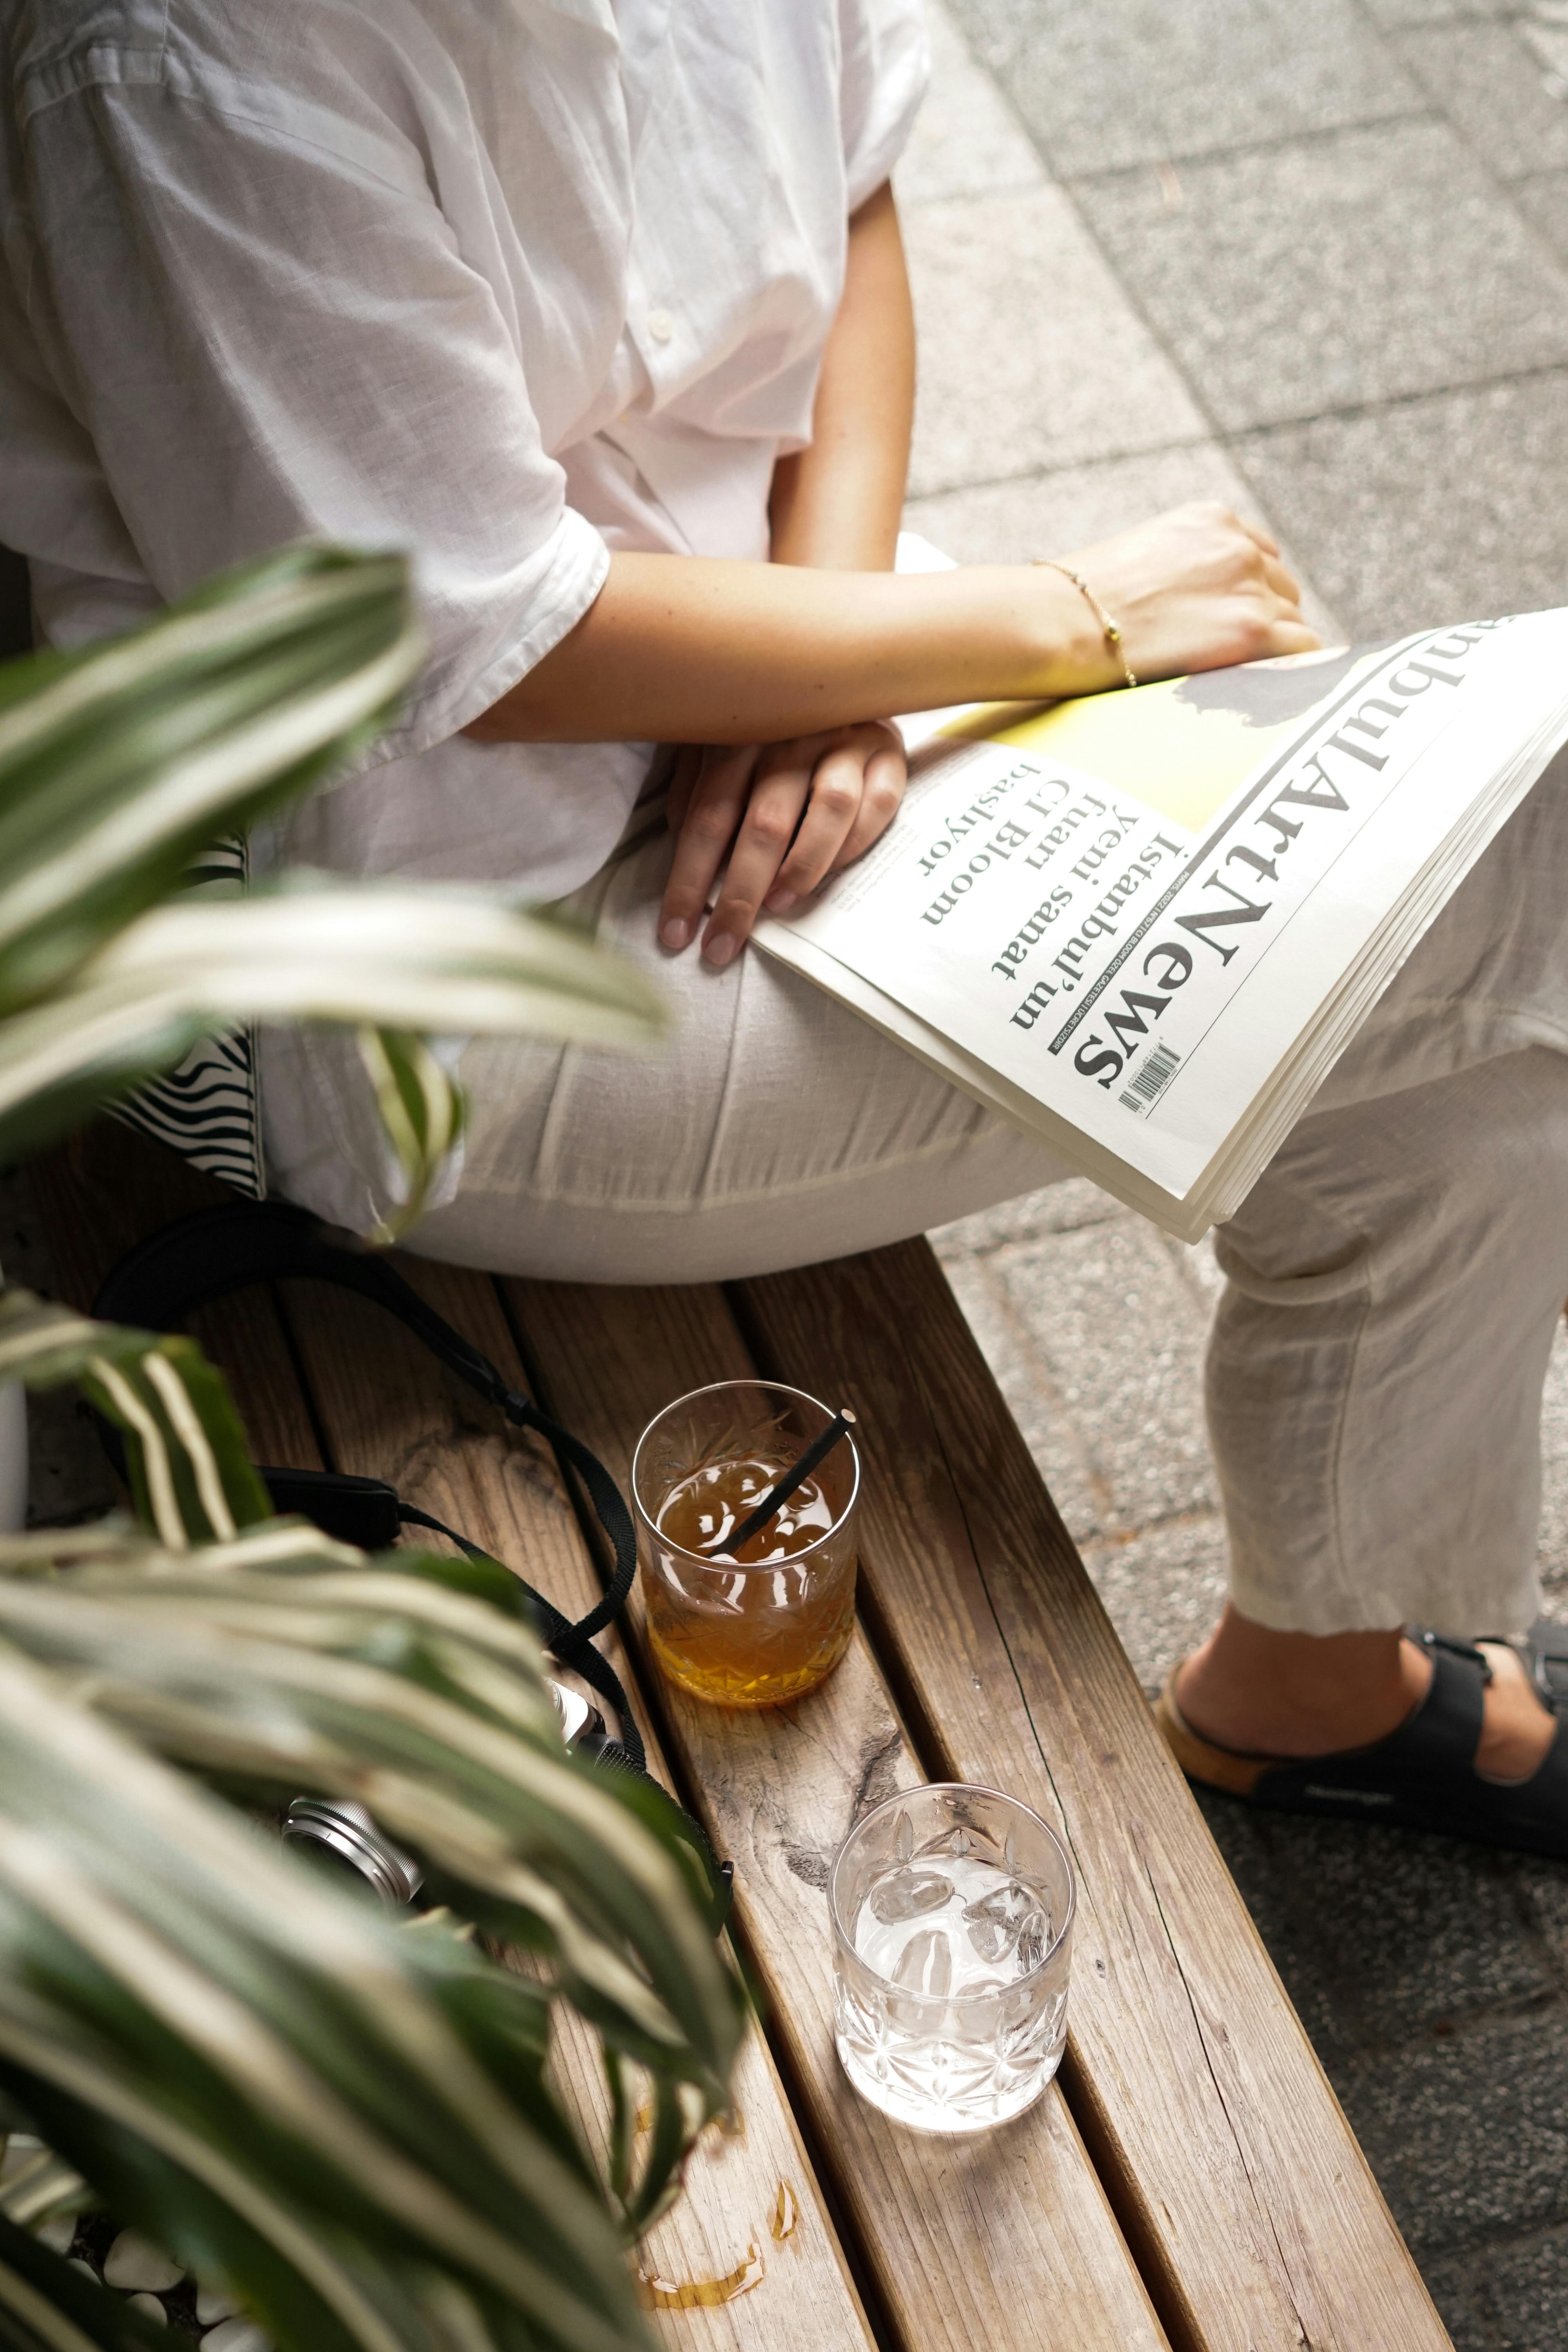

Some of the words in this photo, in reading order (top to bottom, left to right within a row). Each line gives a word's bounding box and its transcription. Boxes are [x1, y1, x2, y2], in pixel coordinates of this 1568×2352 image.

[1025, 780, 1069, 818] CI
[916, 764, 1042, 877] başlıyor
[1024, 794, 1106, 870] fuarı
[1069, 805, 1139, 885] yeni
[920, 820, 1031, 925] Bloom
[1170, 870, 1190, 892] MAYIS,
[1157, 890, 1174, 909] 2022
[992, 886, 1072, 980] sanat
[1118, 936, 1138, 960] BLOOM
[1135, 928, 1144, 937] CI
[1105, 958, 1123, 976] ÖZEL
[1083, 974, 1110, 1006] GAZETESİ
[1052, 1007, 1086, 1050] ÜCRETSİZDİR
